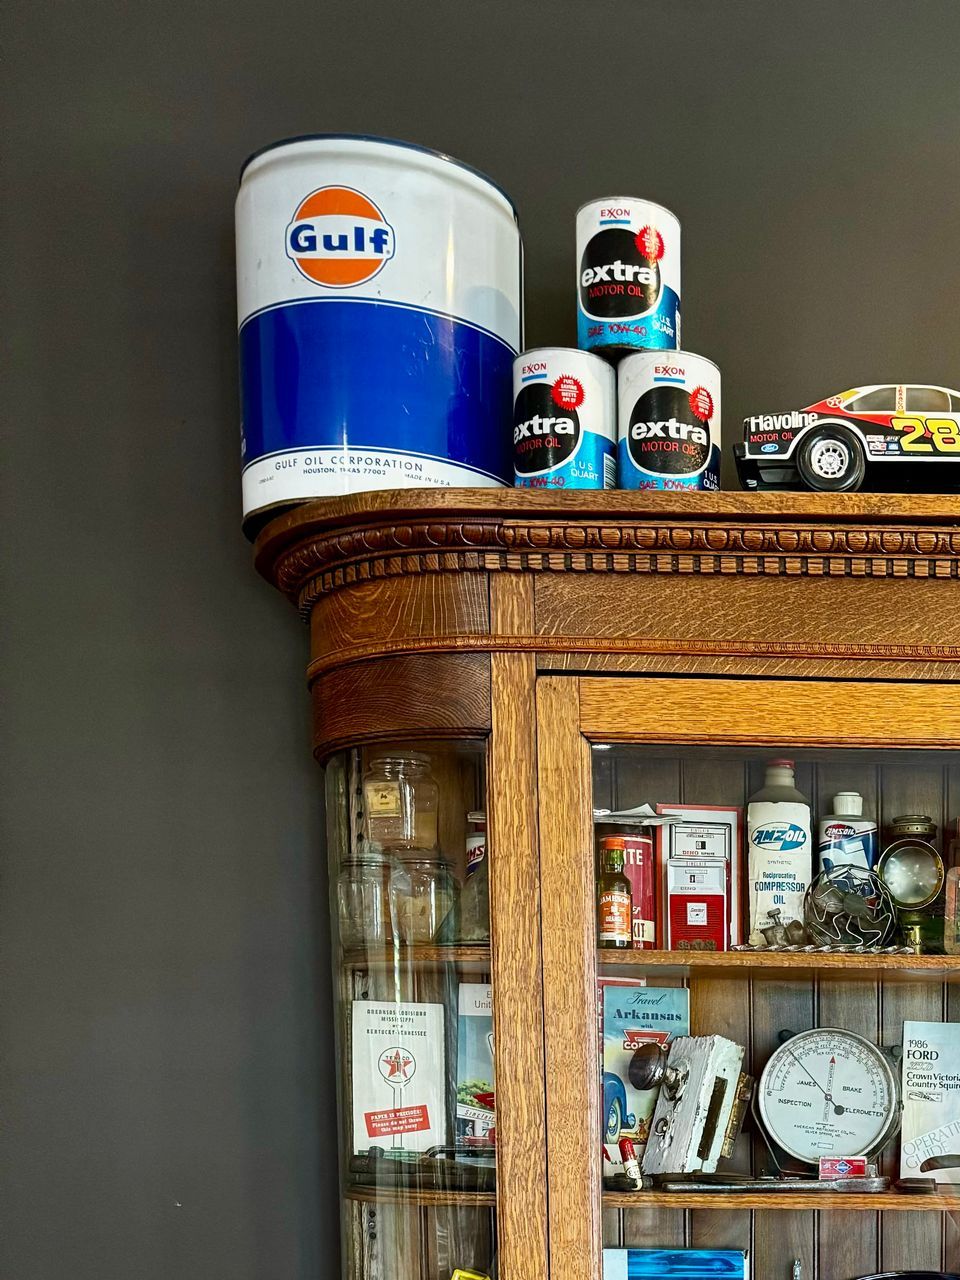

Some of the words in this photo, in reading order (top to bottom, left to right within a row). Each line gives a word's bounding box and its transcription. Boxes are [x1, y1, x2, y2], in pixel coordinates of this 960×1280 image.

[600, 209, 631, 219] EXXON
[290, 223, 390, 255] Gulf
[581, 259, 656, 287] extra
[589, 284, 625, 299] MOTOR
[627, 284, 645, 298] OIL
[522, 363, 547, 374] EXXON
[654, 365, 685, 377] EXXON
[750, 411, 819, 433] Havoline
[514, 414, 575, 445] extra
[631, 417, 707, 446] extra
[750, 433, 780, 443] MOTOR
[782, 432, 795, 441] OIL
[274, 458, 299, 471] GULF
[304, 456, 323, 466] OIL
[751, 828, 806, 845] AMZOIL
[762, 871, 796, 881] Reciprocating
[754, 880, 805, 892] COMPRESSOR
[773, 894, 786, 905] OIL
[626, 991, 667, 1006] Travel
[613, 1009, 682, 1021] Arkansas
[907, 1039, 928, 1049] 1986
[907, 1050, 939, 1061] FORD
[907, 1071, 932, 1081] Crown
[796, 1080, 817, 1088] JAMES
[842, 1086, 863, 1094] BRAKE
[907, 1080, 938, 1091] Country
